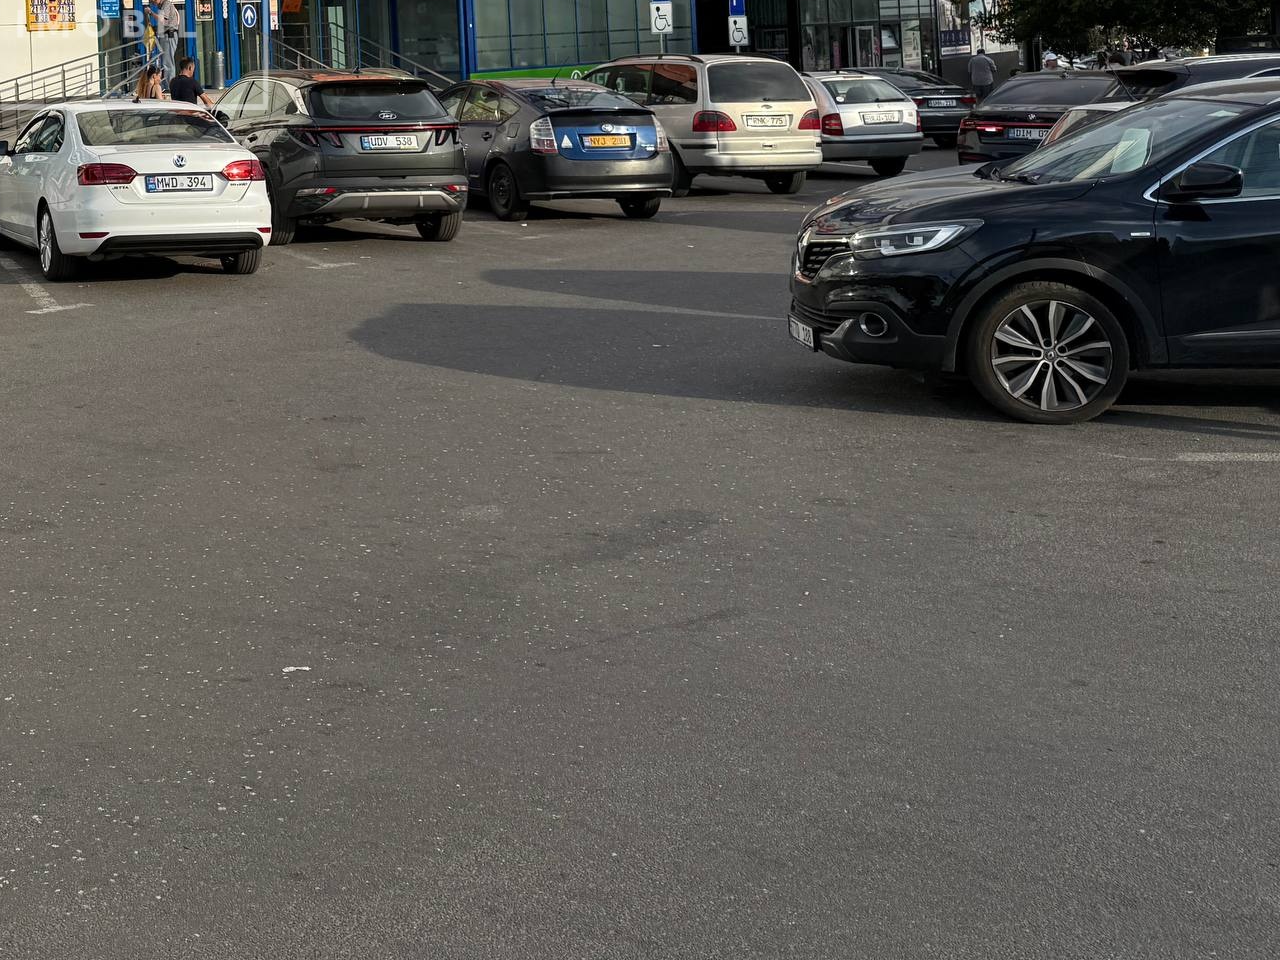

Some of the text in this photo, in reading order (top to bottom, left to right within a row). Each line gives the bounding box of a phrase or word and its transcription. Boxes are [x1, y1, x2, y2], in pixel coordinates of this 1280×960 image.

[1016, 129, 1032, 137] DIM
[370, 136, 412, 146] UDV 538
[157, 176, 207, 188] MWD 394
